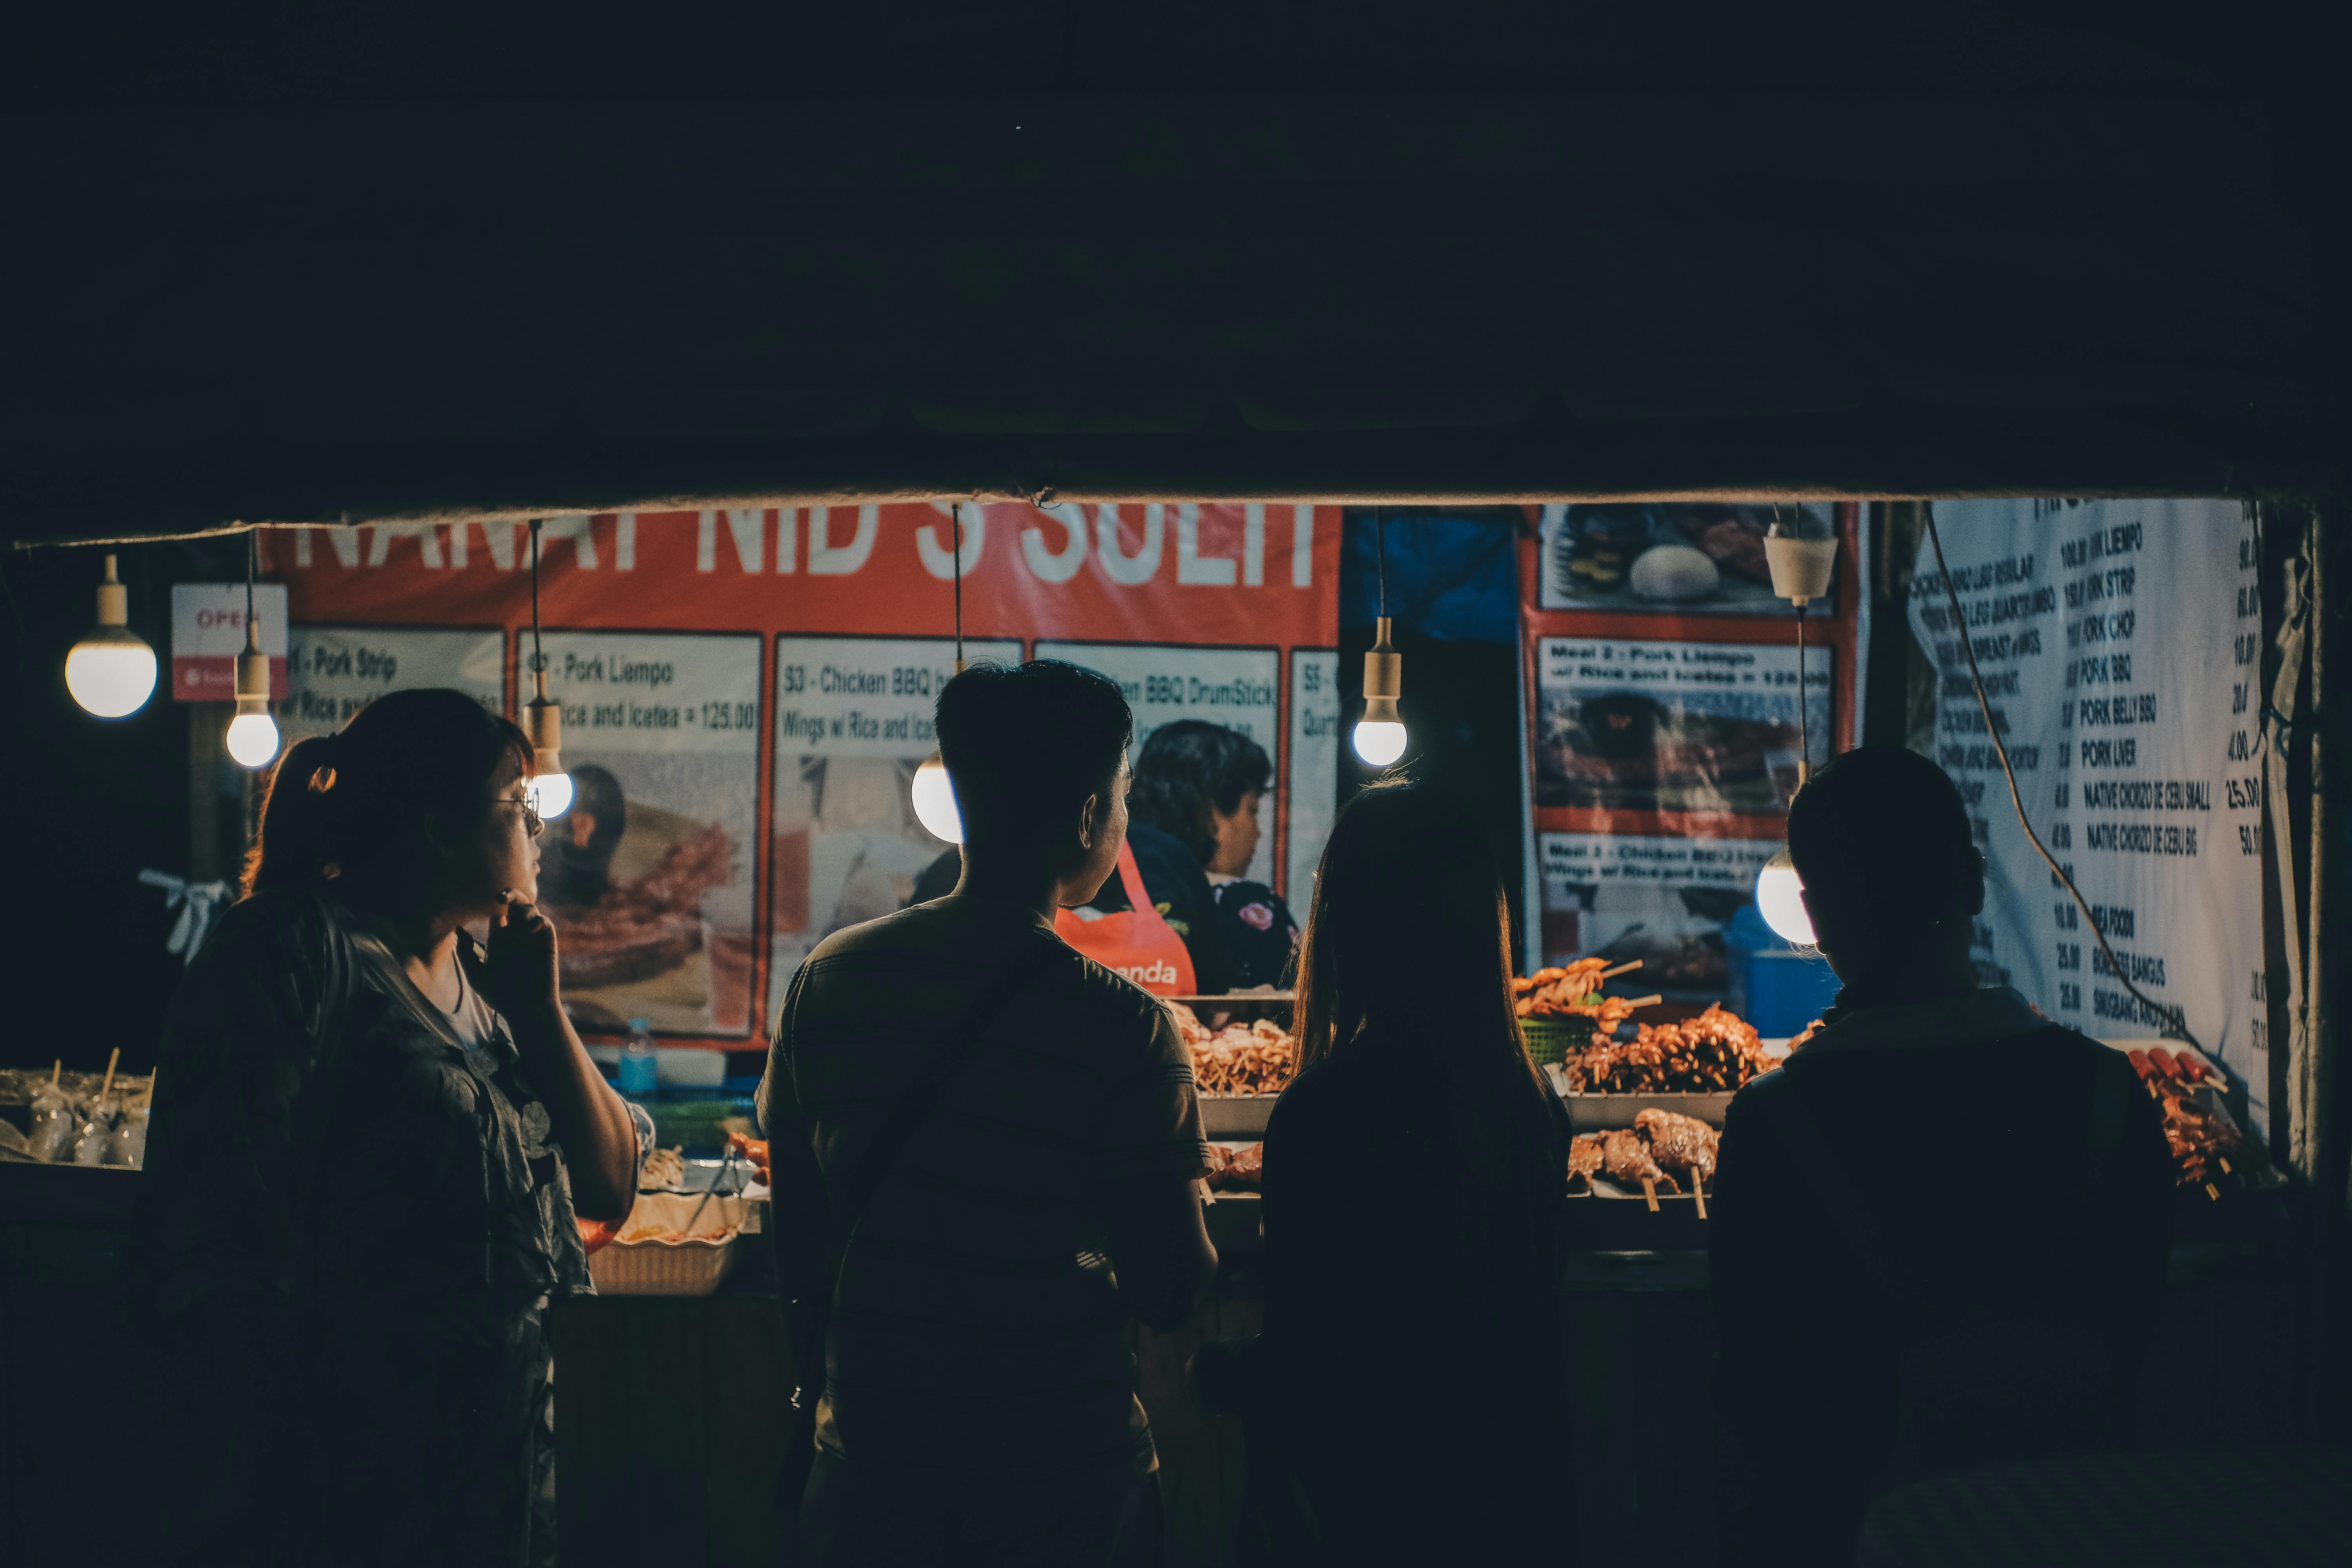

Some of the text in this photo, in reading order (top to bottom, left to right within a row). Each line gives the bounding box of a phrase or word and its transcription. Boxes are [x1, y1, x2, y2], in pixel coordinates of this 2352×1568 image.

[564, 651, 603, 682] Pork
[1551, 644, 1596, 660] Meal
[820, 665, 886, 695] Chicken
[892, 666, 929, 696] BBQ
[2080, 655, 2109, 685] PORK
[1145, 674, 1183, 704] BBQ
[592, 701, 624, 728] and
[2080, 698, 2111, 727] PORK
[784, 711, 825, 745] Wings
[2082, 740, 2112, 768] PORK
[2083, 780, 2118, 811] NATIVE
[2225, 777, 2260, 809] 25.00
[2087, 823, 2118, 852] NATIVE
[1116, 959, 1177, 985] anda
